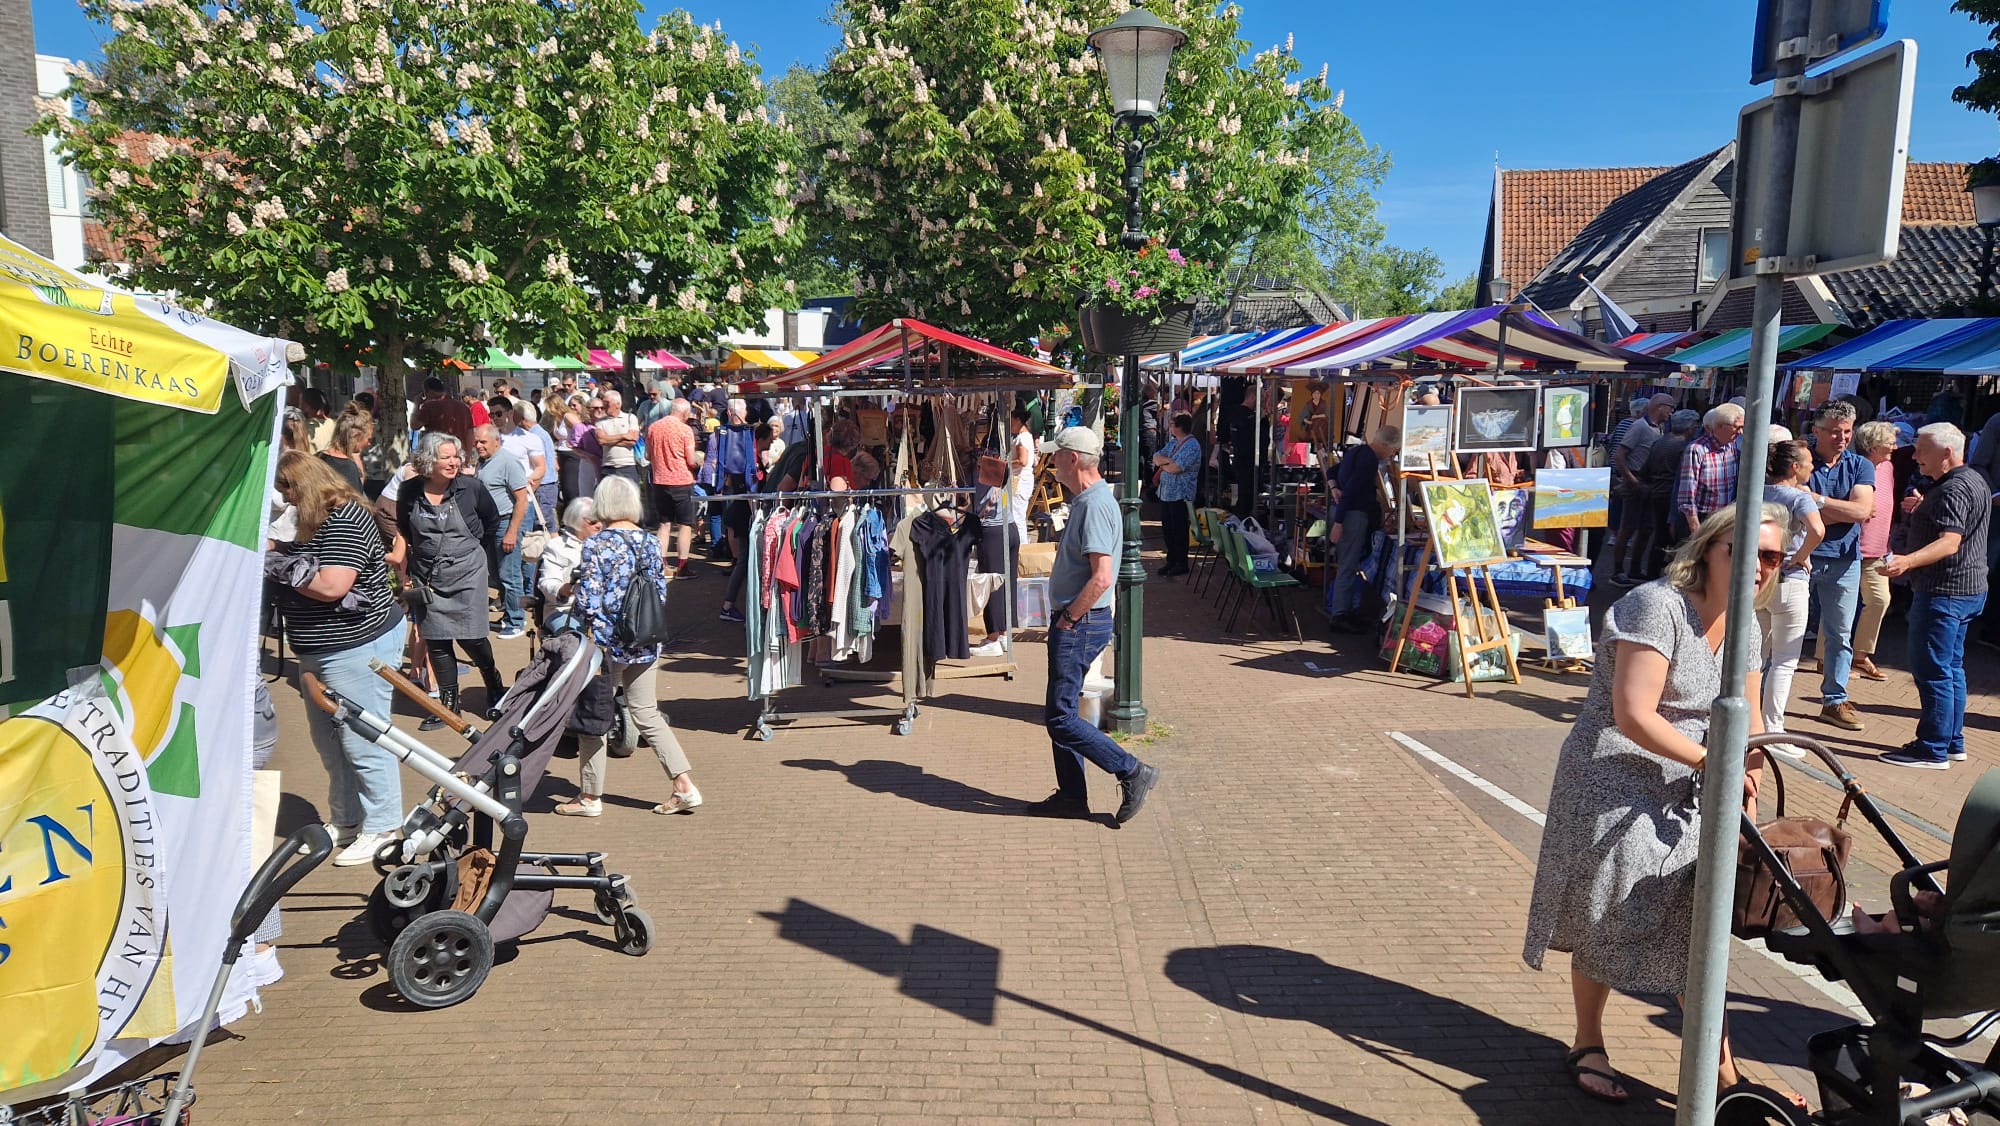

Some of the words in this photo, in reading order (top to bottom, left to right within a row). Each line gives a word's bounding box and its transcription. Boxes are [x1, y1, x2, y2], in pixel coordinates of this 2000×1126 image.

[16, 334, 200, 398] BOERENKAAS
[89, 327, 134, 354] Echte
[78, 701, 155, 889] TRADITIES
[119, 905, 153, 968] VAN
